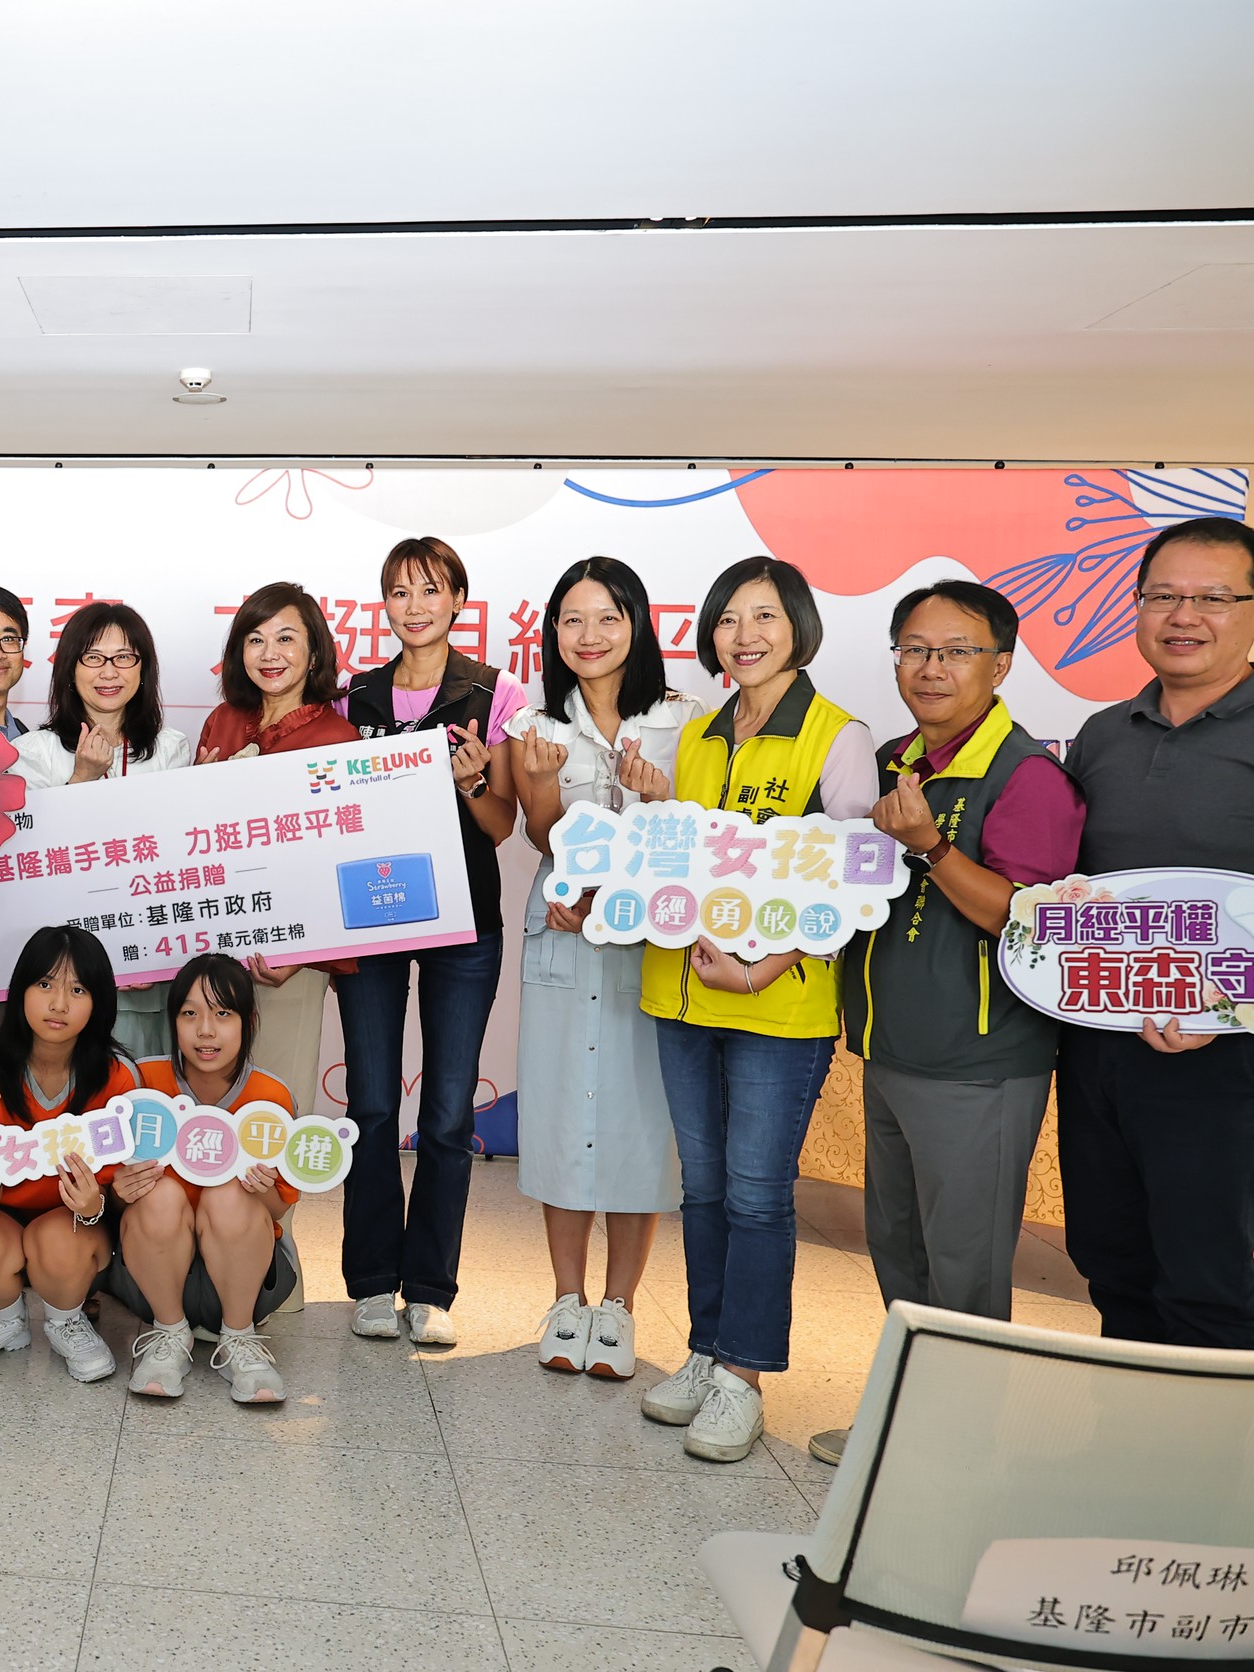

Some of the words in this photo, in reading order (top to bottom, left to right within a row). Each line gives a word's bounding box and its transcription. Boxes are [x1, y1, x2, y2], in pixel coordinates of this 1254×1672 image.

[346, 748, 433, 776] KEELUNG
[356, 776, 369, 786] city
[370, 774, 383, 783] full
[383, 773, 391, 781] of
[185, 803, 365, 857] 力挺月經平權
[560, 811, 897, 886] 台灣女孩日
[128, 863, 226, 897] 公益捐贈
[610, 892, 837, 937] 月經勇敢說
[1035, 902, 1217, 944] 月經平權
[1110, 1554, 1250, 1593] 邱佩琳
[1026, 1595, 1254, 1643] 基隆市副市
